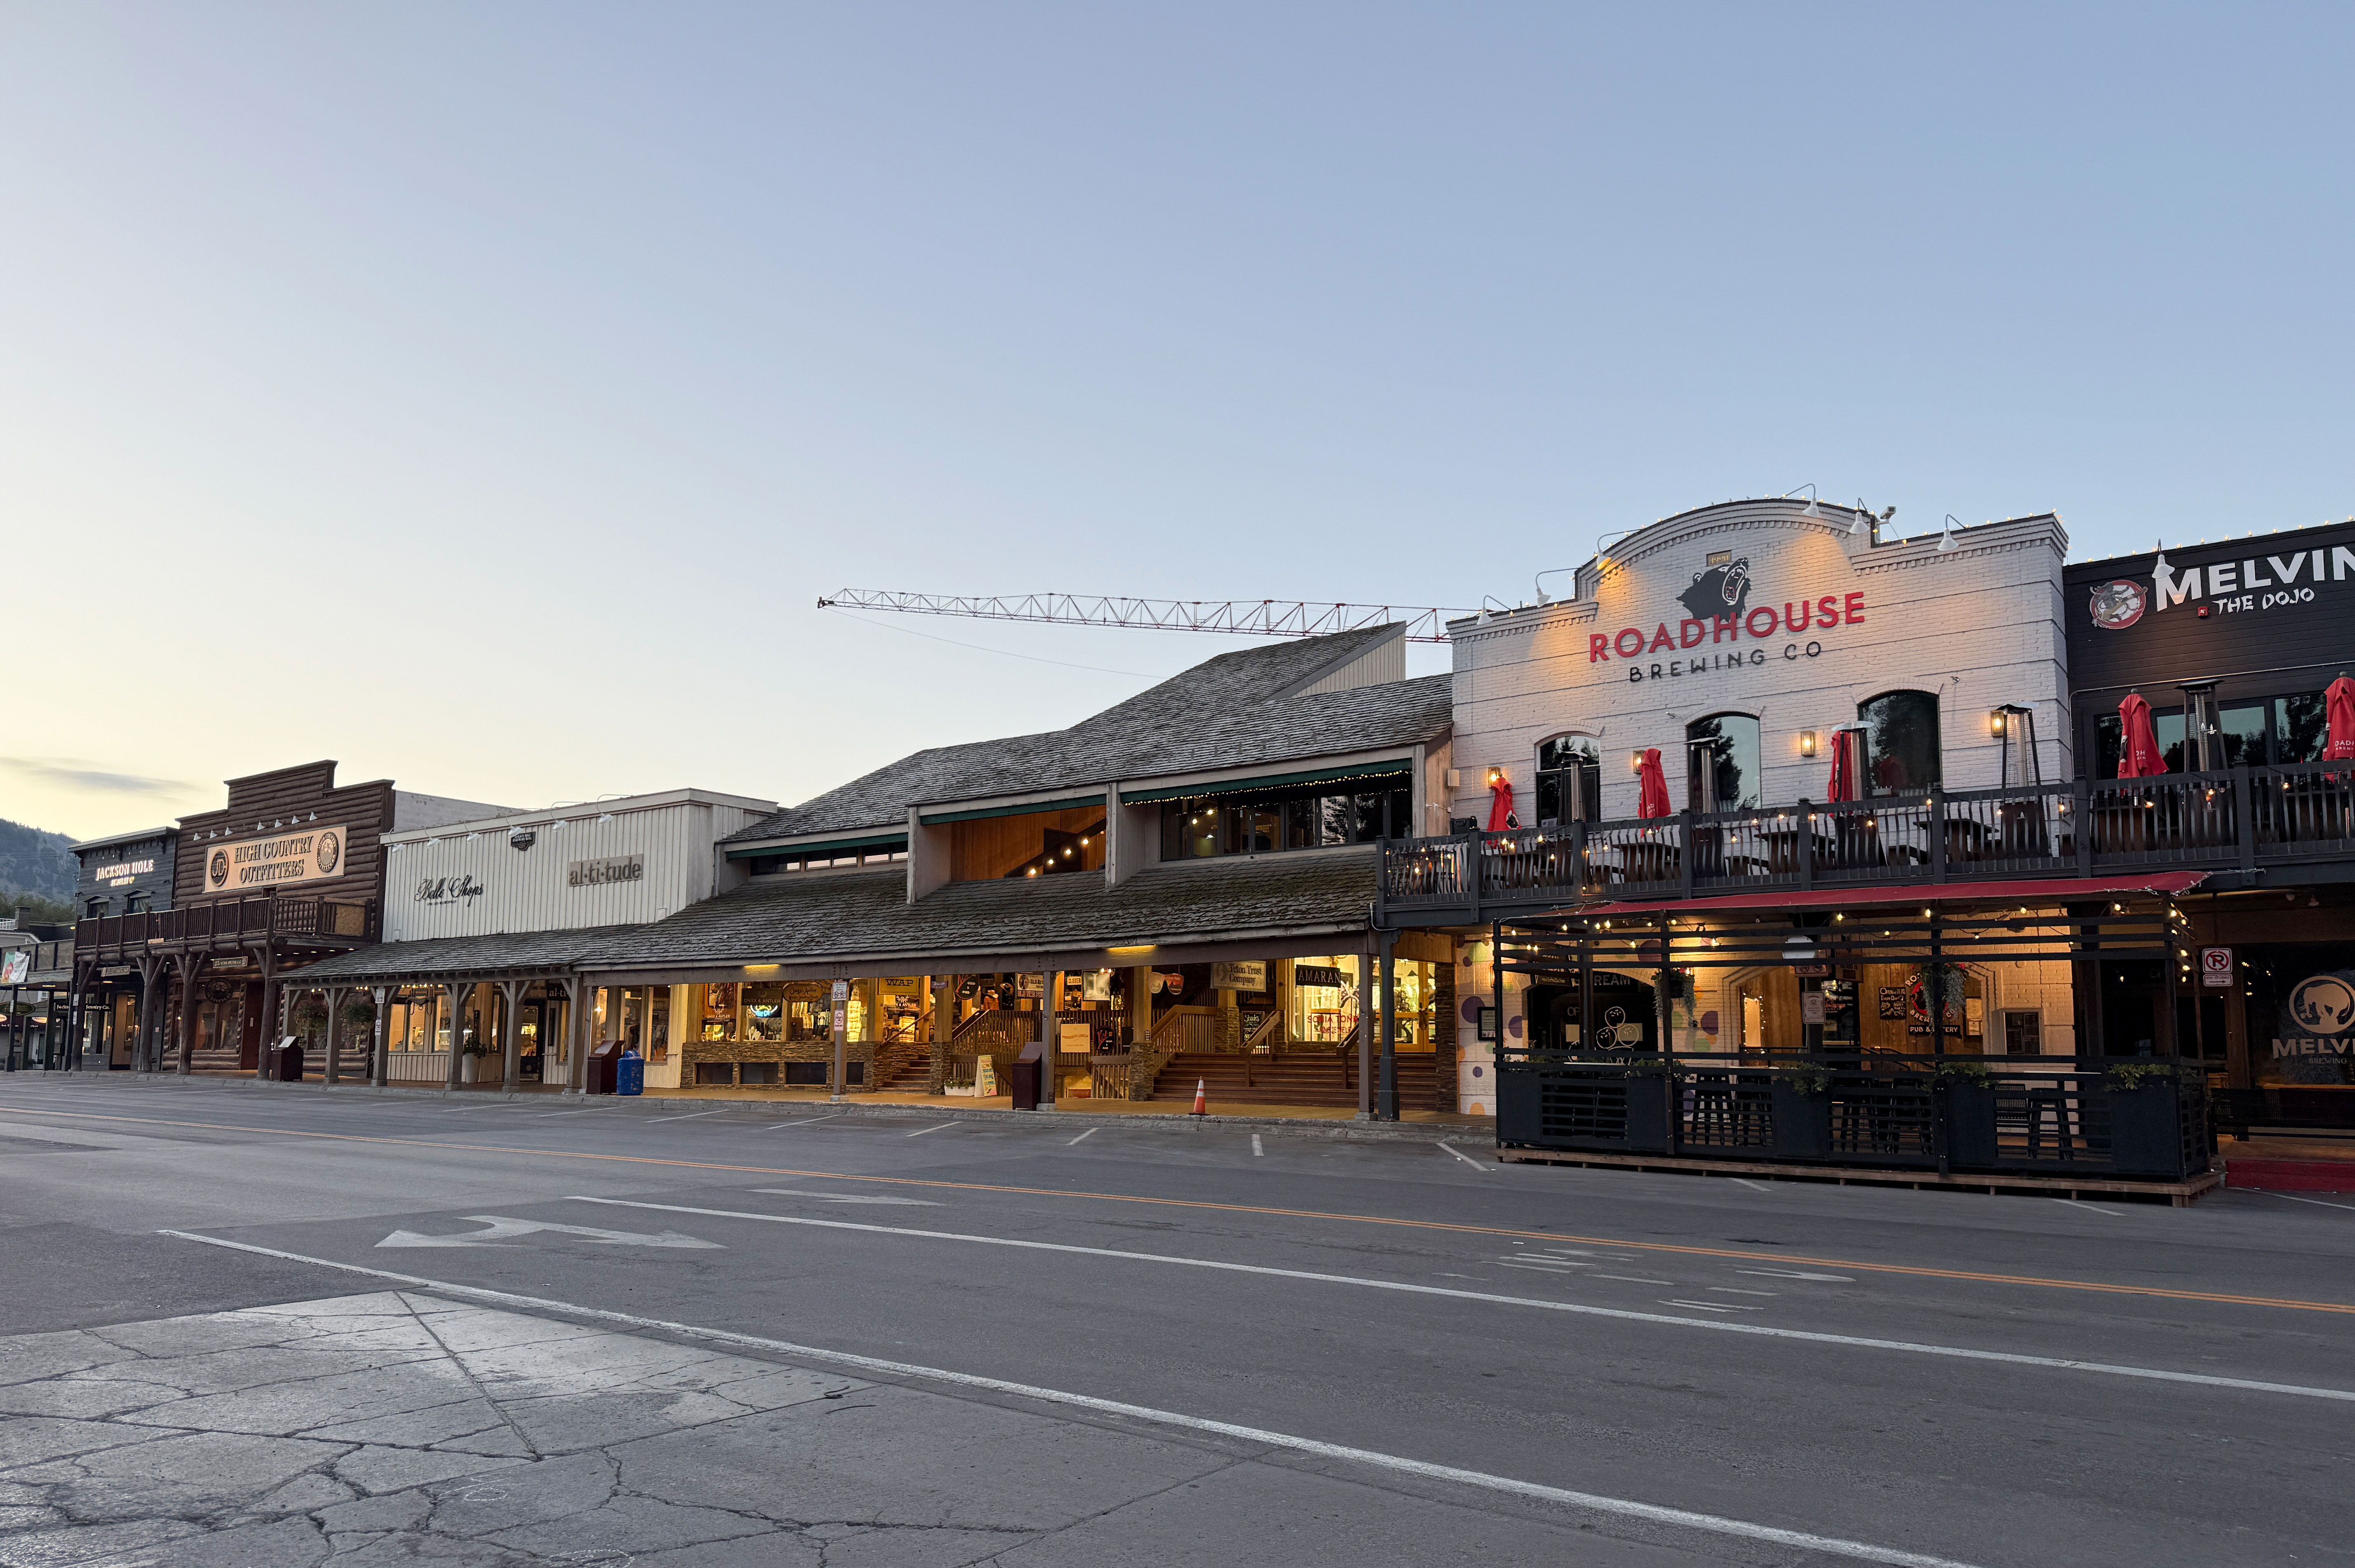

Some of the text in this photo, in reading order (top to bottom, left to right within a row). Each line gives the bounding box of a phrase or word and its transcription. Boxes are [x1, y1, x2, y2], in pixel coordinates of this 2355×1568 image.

[2212, 588, 2315, 615] THE DOJO
[1589, 592, 1865, 662] ROADHOUSE
[1629, 641, 1821, 682] BREWING CO
[234, 835, 313, 864] HIGH COUNTRY
[95, 859, 154, 881] JACKSON HOLE
[239, 859, 305, 883] OUTFITTERS
[414, 877, 446, 901] Belle
[1229, 963, 1262, 975] Teton Trust
[1229, 973, 1256, 986] Company
[1594, 975, 1630, 986] REAM
